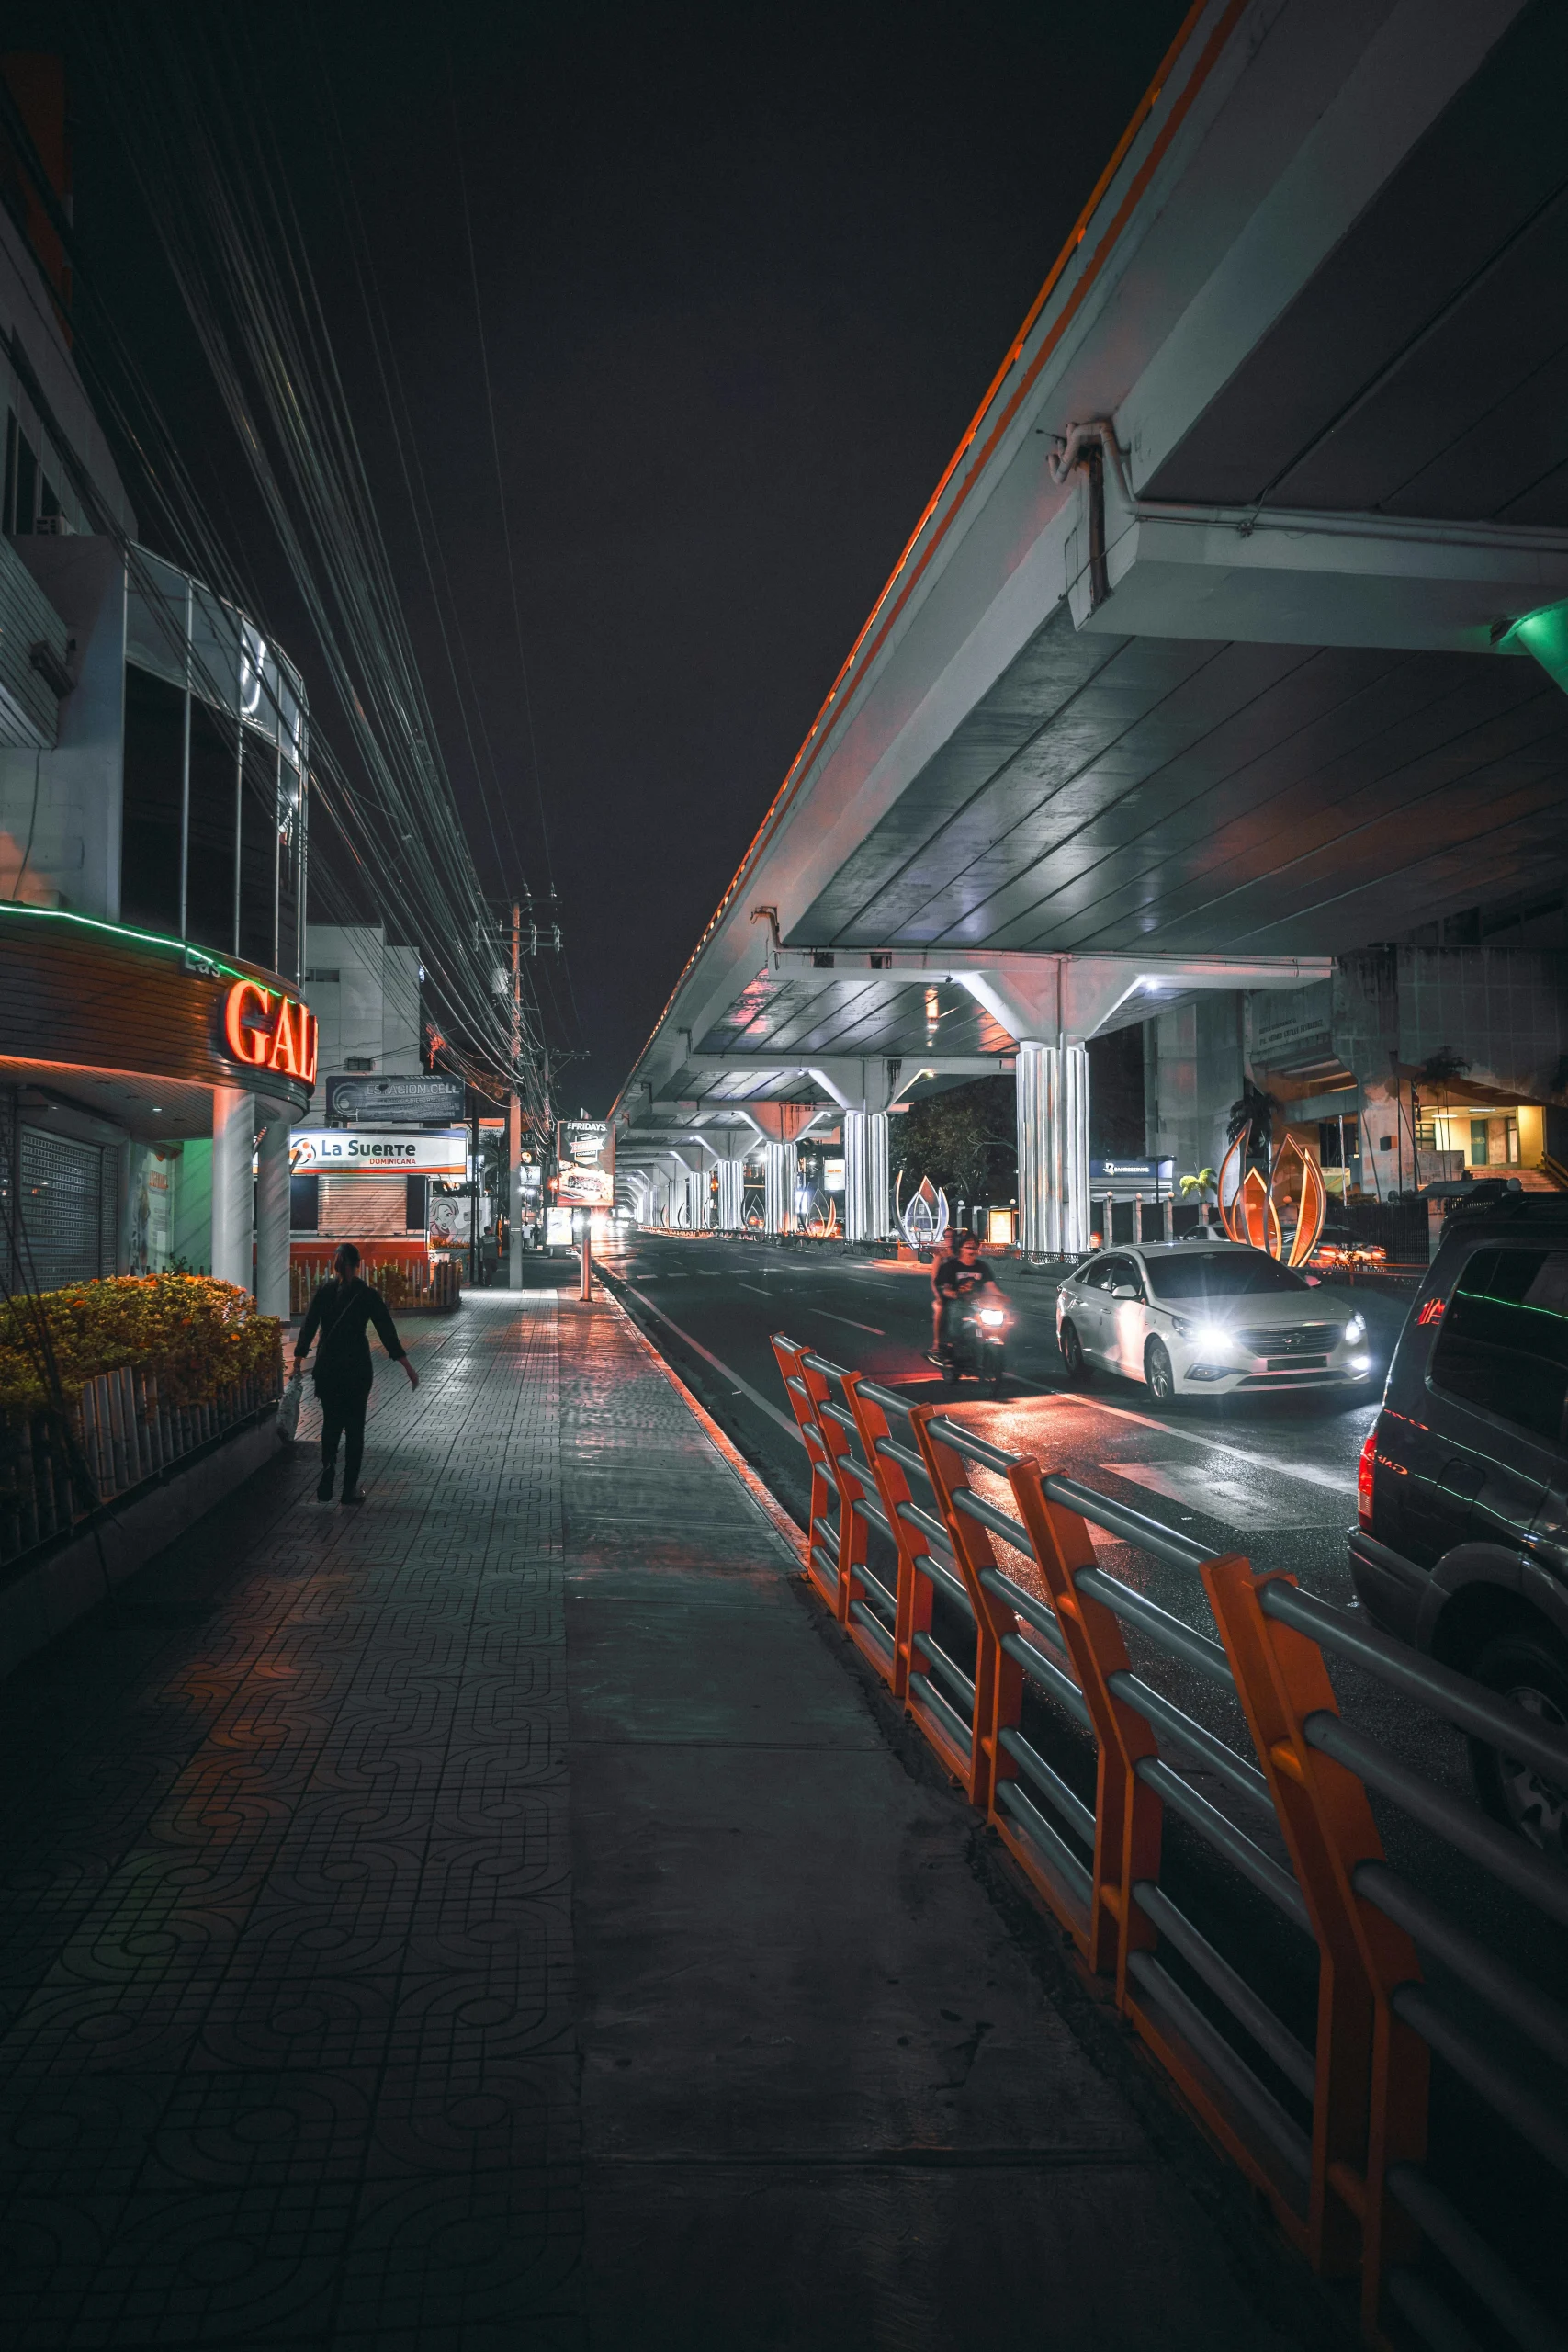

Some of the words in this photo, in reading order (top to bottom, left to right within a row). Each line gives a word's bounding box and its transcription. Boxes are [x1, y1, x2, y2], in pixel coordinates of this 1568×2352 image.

[367, 1082, 425, 1095] ESACIÓN
[571, 1123, 606, 1132] FRIDAYS
[321, 1140, 342, 1156] La
